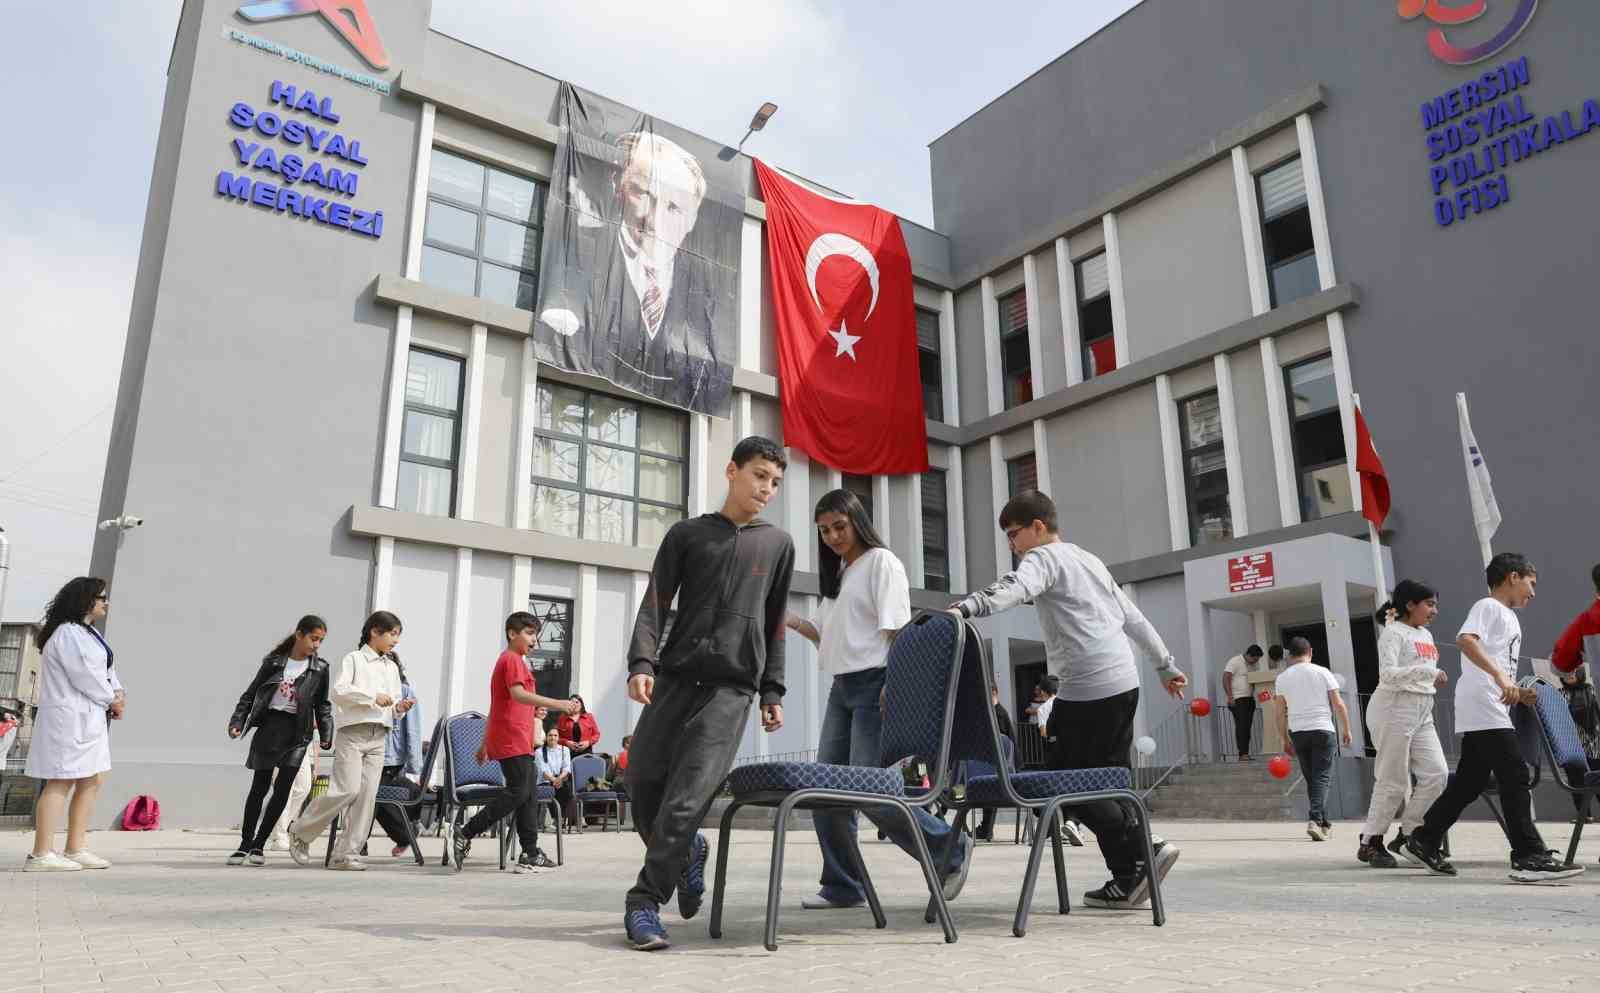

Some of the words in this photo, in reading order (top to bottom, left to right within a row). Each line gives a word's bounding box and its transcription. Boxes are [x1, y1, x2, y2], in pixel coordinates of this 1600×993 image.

[271, 79, 340, 124] HAL
[1426, 94, 1534, 161] SOSYAL
[230, 102, 369, 167] SOSYAL
[233, 137, 360, 198] YAŞAM
